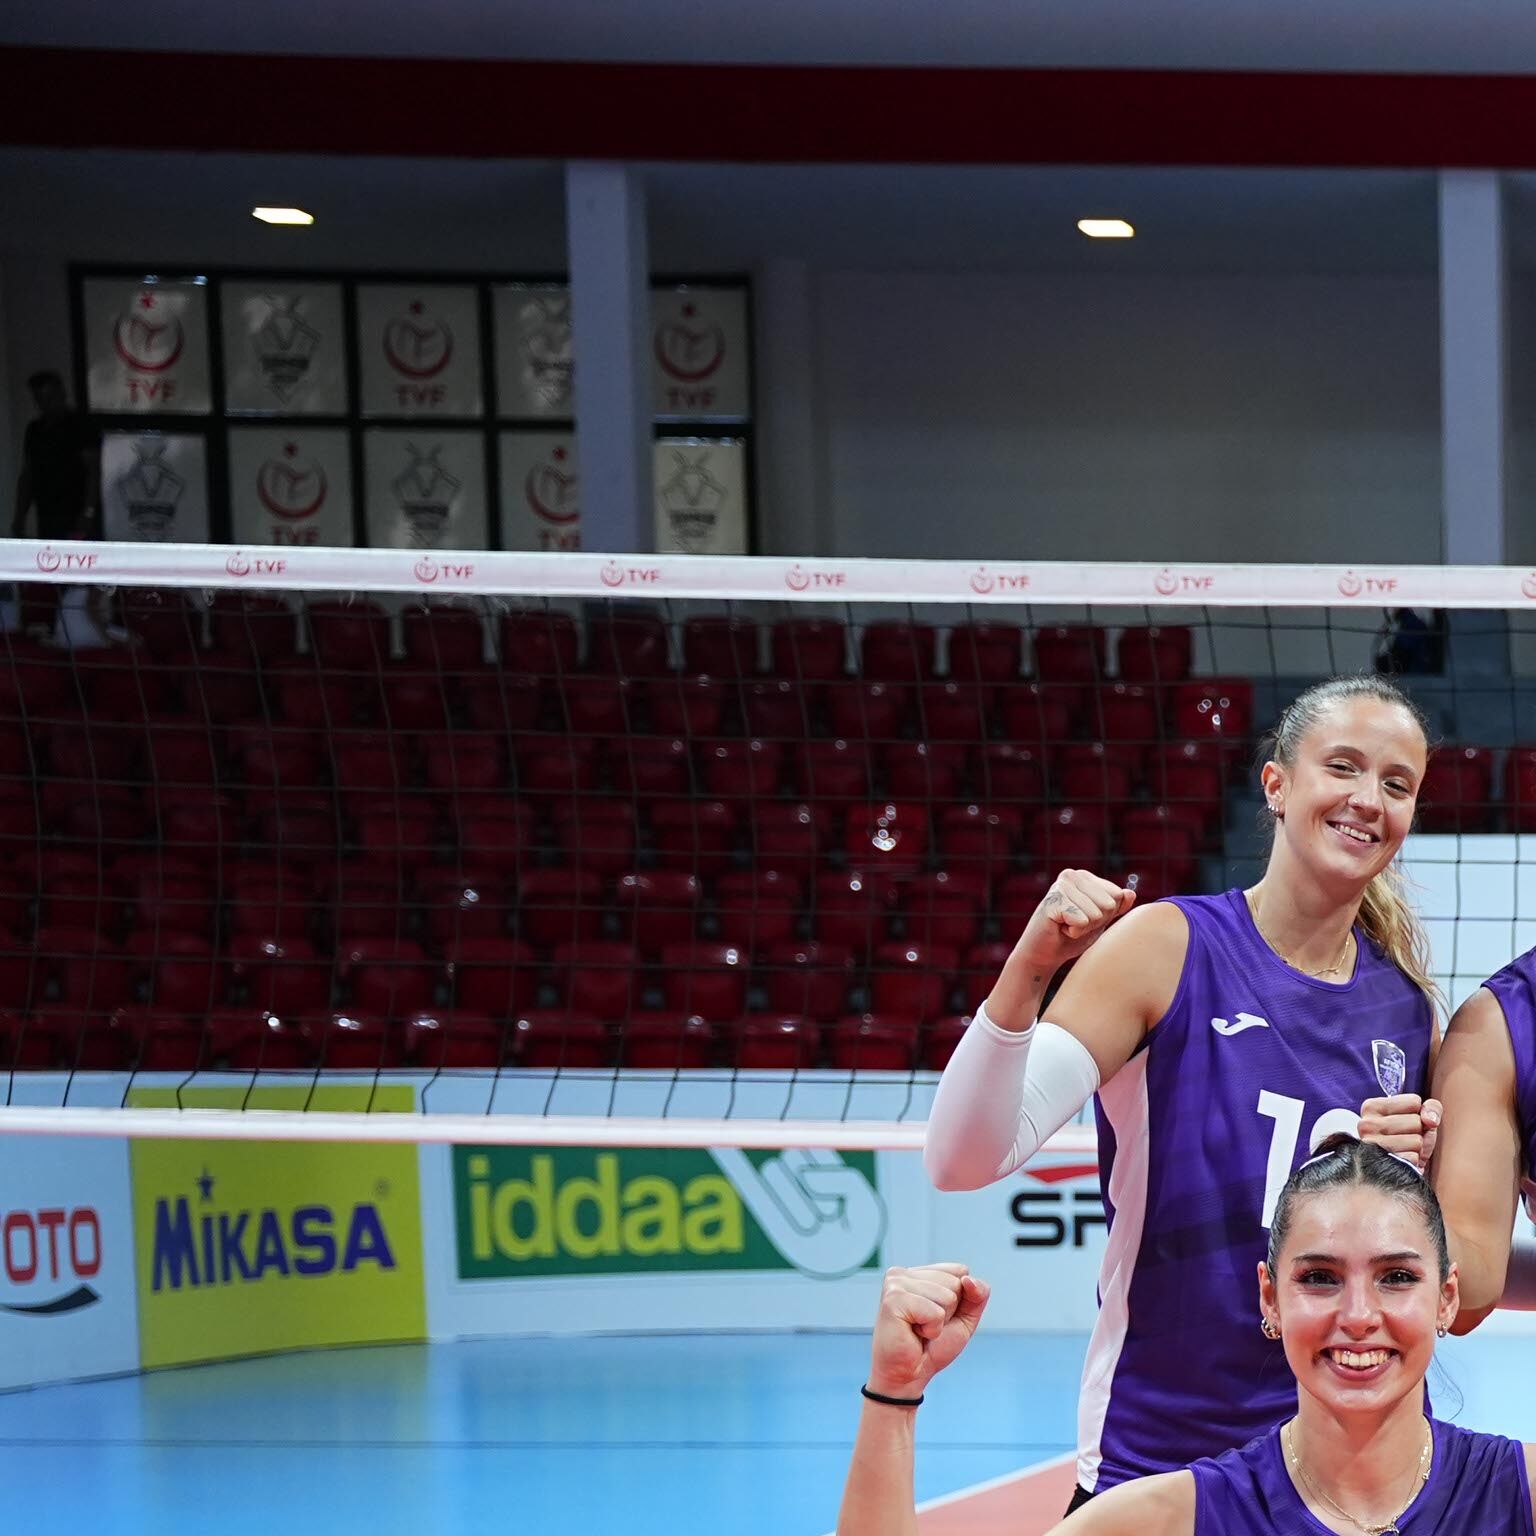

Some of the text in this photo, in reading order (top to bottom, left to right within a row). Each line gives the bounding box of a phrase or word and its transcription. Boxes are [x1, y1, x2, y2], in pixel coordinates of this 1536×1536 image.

[126, 379, 177, 402] TVF
[395, 383, 447, 407] TVF
[64, 555, 99, 569] TVF
[254, 560, 287, 574] TVF
[441, 565, 475, 579] TVF
[628, 569, 661, 583] TVF
[812, 573, 846, 587] TVF
[997, 576, 1030, 590] TVF
[1180, 577, 1214, 591] TVF
[1365, 578, 1398, 592] TVF
[1256, 1089, 1361, 1229] 1
[468, 1155, 744, 1262] iddaa
[0, 1205, 103, 1284] OTO
